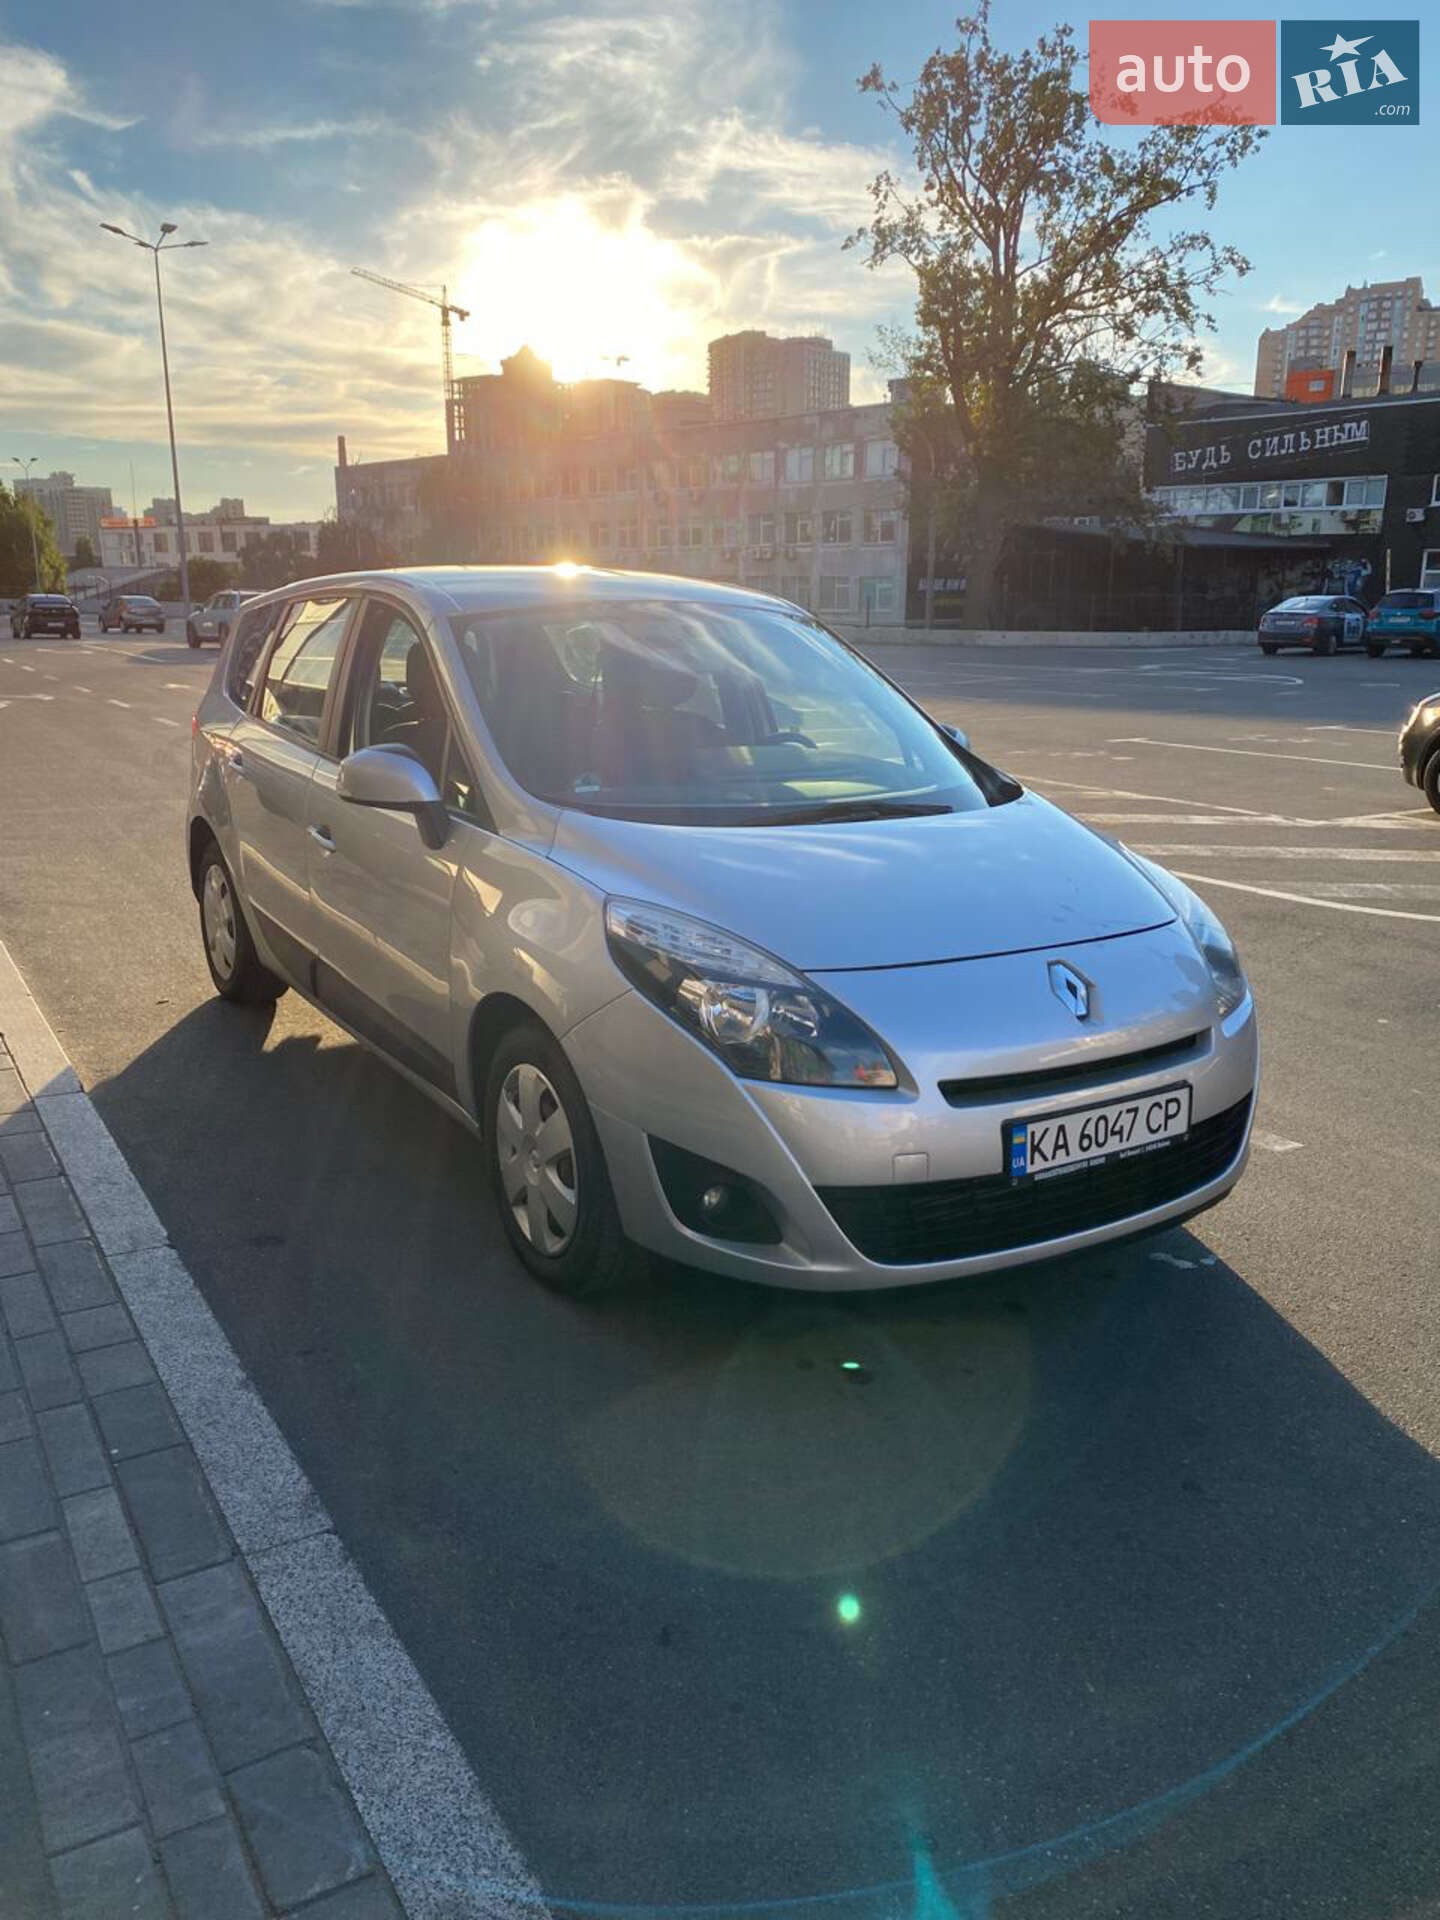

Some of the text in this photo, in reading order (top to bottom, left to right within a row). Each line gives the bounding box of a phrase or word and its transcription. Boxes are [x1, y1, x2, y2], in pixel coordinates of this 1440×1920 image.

[1173, 420, 1369, 473] БУДЬ СИЛЬНЫМ
[1029, 1124, 1071, 1166] KA
[1078, 1107, 1140, 1152] 6047
[1145, 1097, 1182, 1135] CP
[1012, 1157, 1025, 1169] UA
